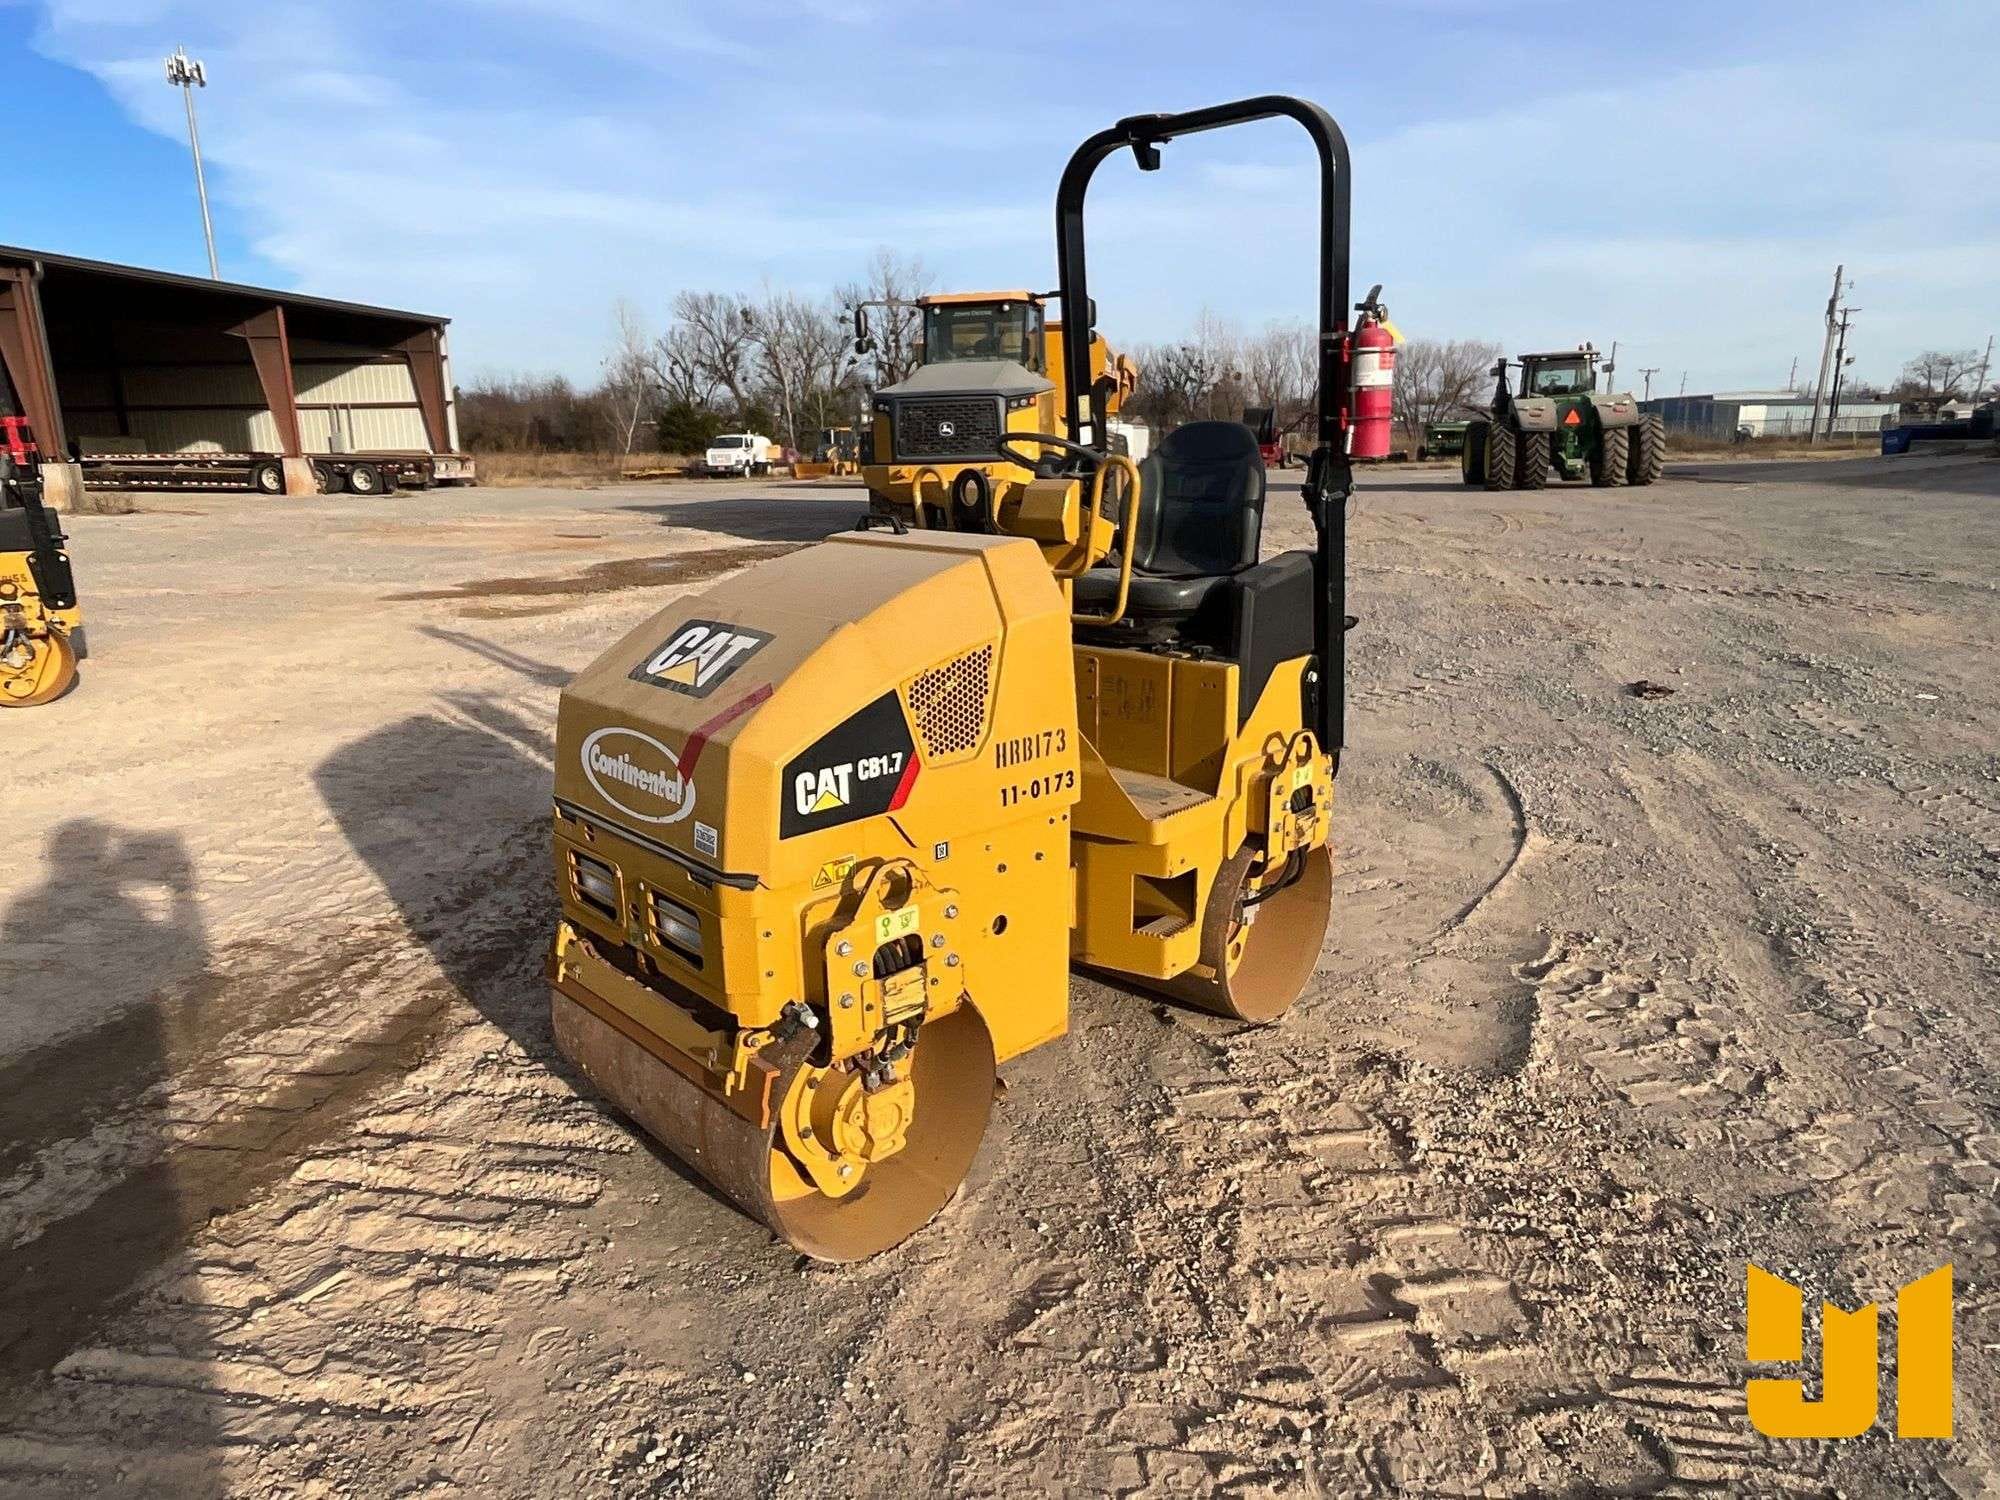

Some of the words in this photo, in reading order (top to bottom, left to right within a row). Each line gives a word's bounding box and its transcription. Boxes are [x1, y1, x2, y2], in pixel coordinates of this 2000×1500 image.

[646, 626, 760, 688] CAT
[590, 744, 683, 805] Continental
[995, 728, 1066, 769] HRB173
[795, 763, 853, 815] CAT
[857, 751, 903, 781] CB1.7
[1000, 770, 1074, 807] 11-0173
